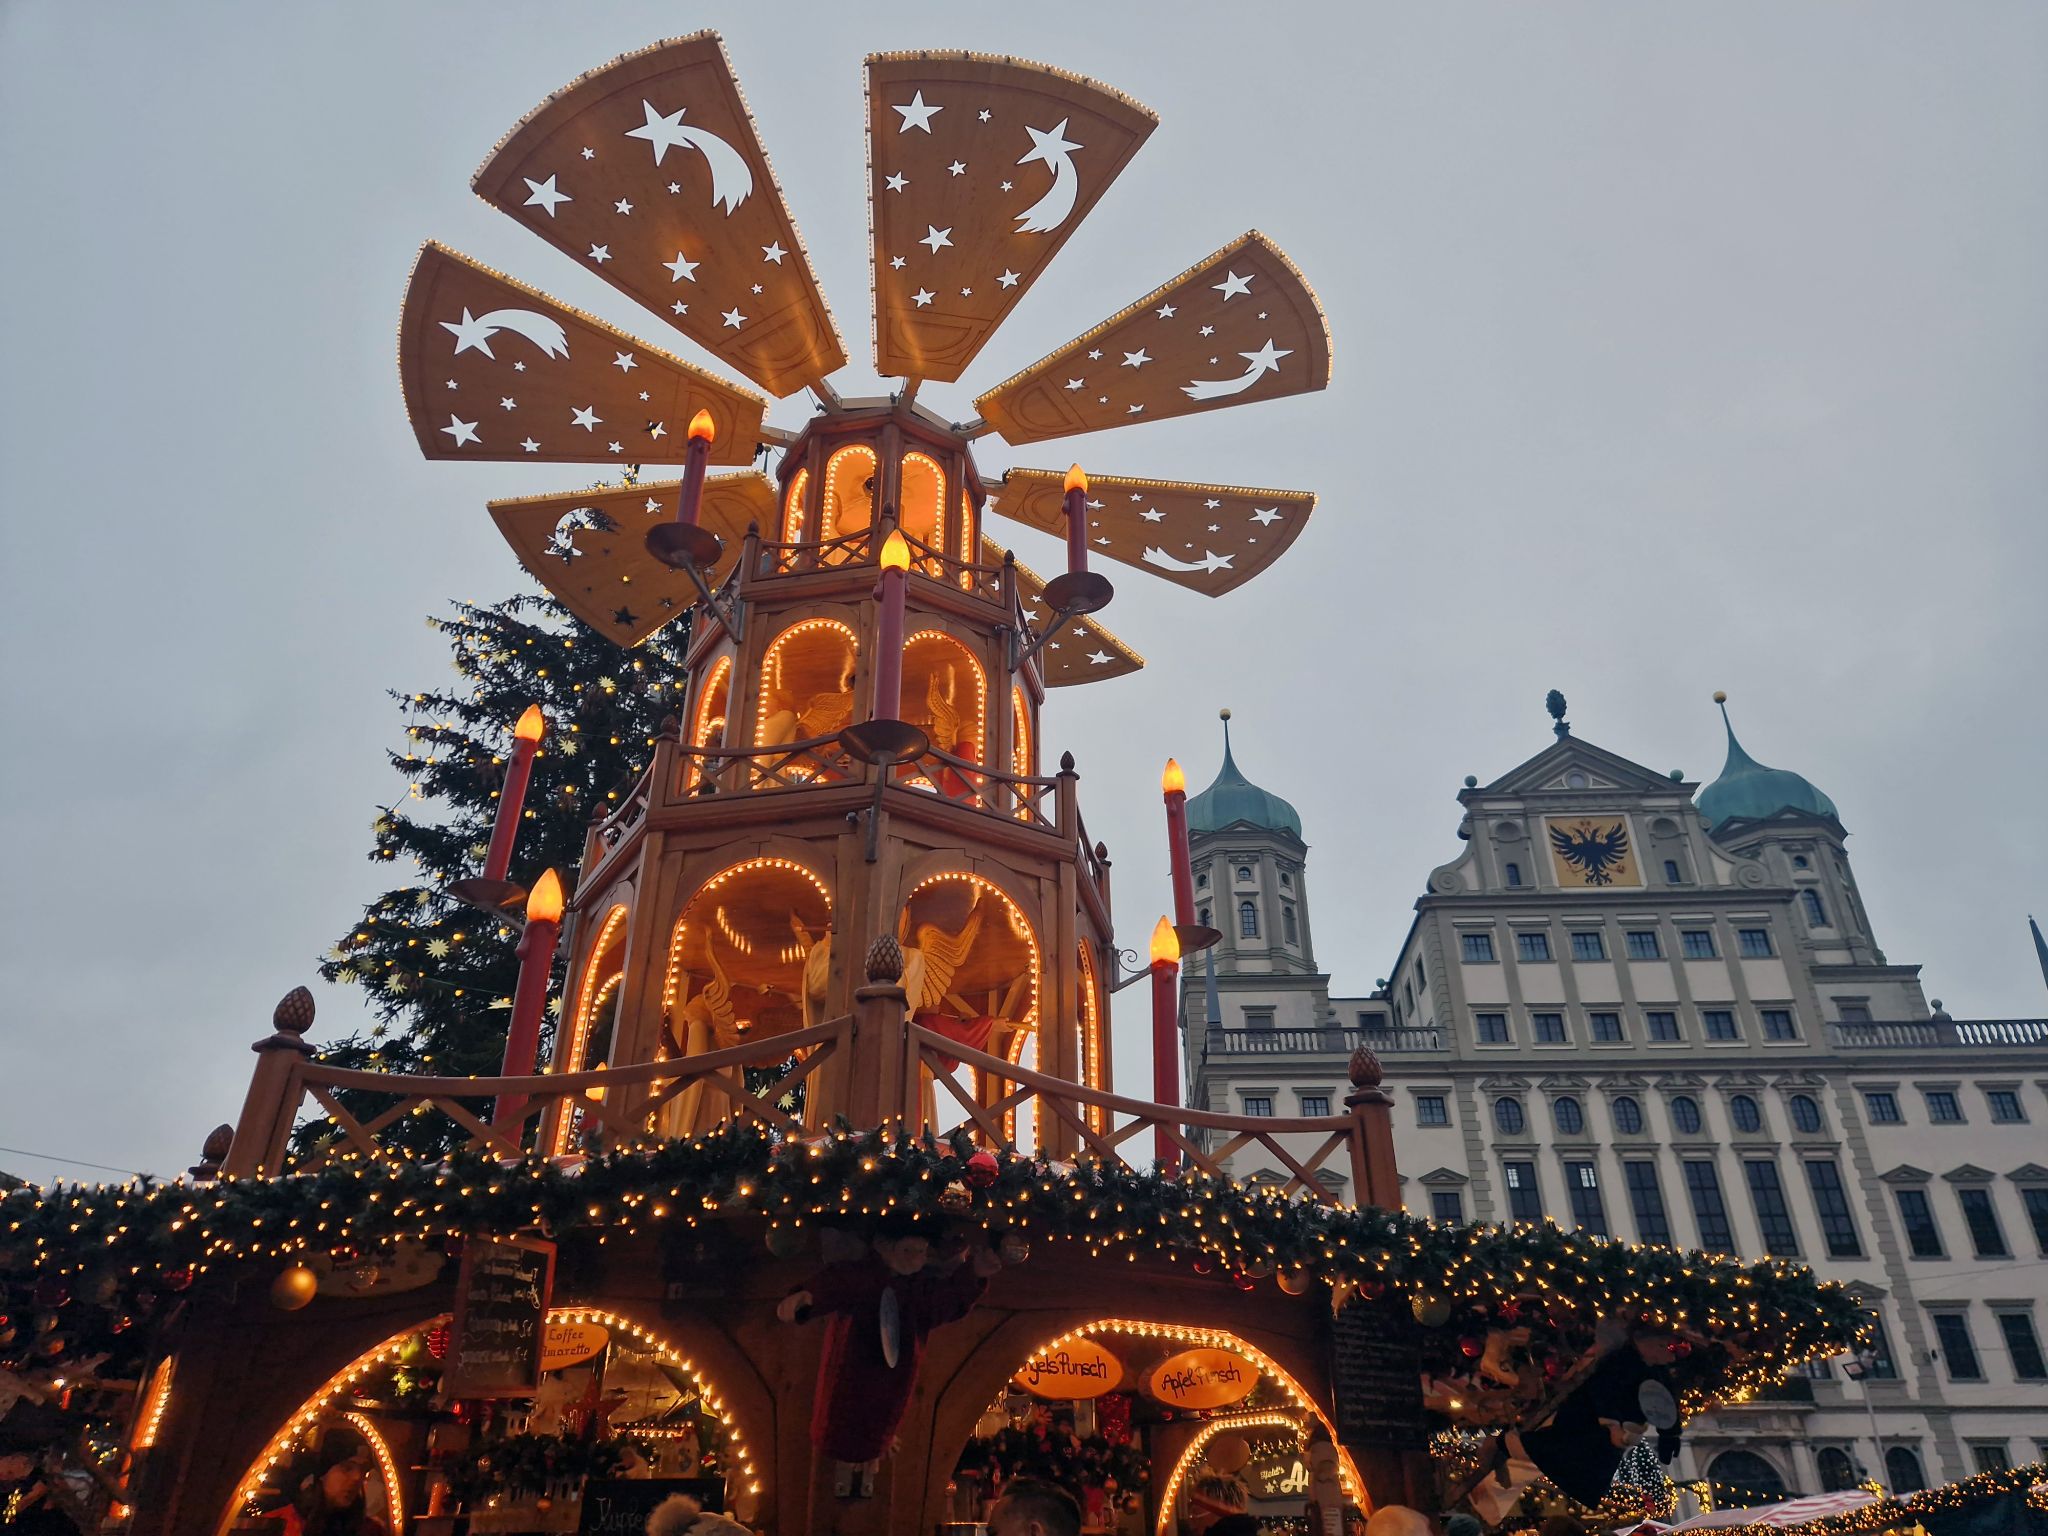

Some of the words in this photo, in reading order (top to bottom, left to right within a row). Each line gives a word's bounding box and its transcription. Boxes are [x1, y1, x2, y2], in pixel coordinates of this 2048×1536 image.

[549, 1328, 585, 1344] Coffee
[1024, 1353, 1060, 1386] ngels
[1161, 1367, 1197, 1400] Apfel
[1194, 1361, 1243, 1386] Punsch
